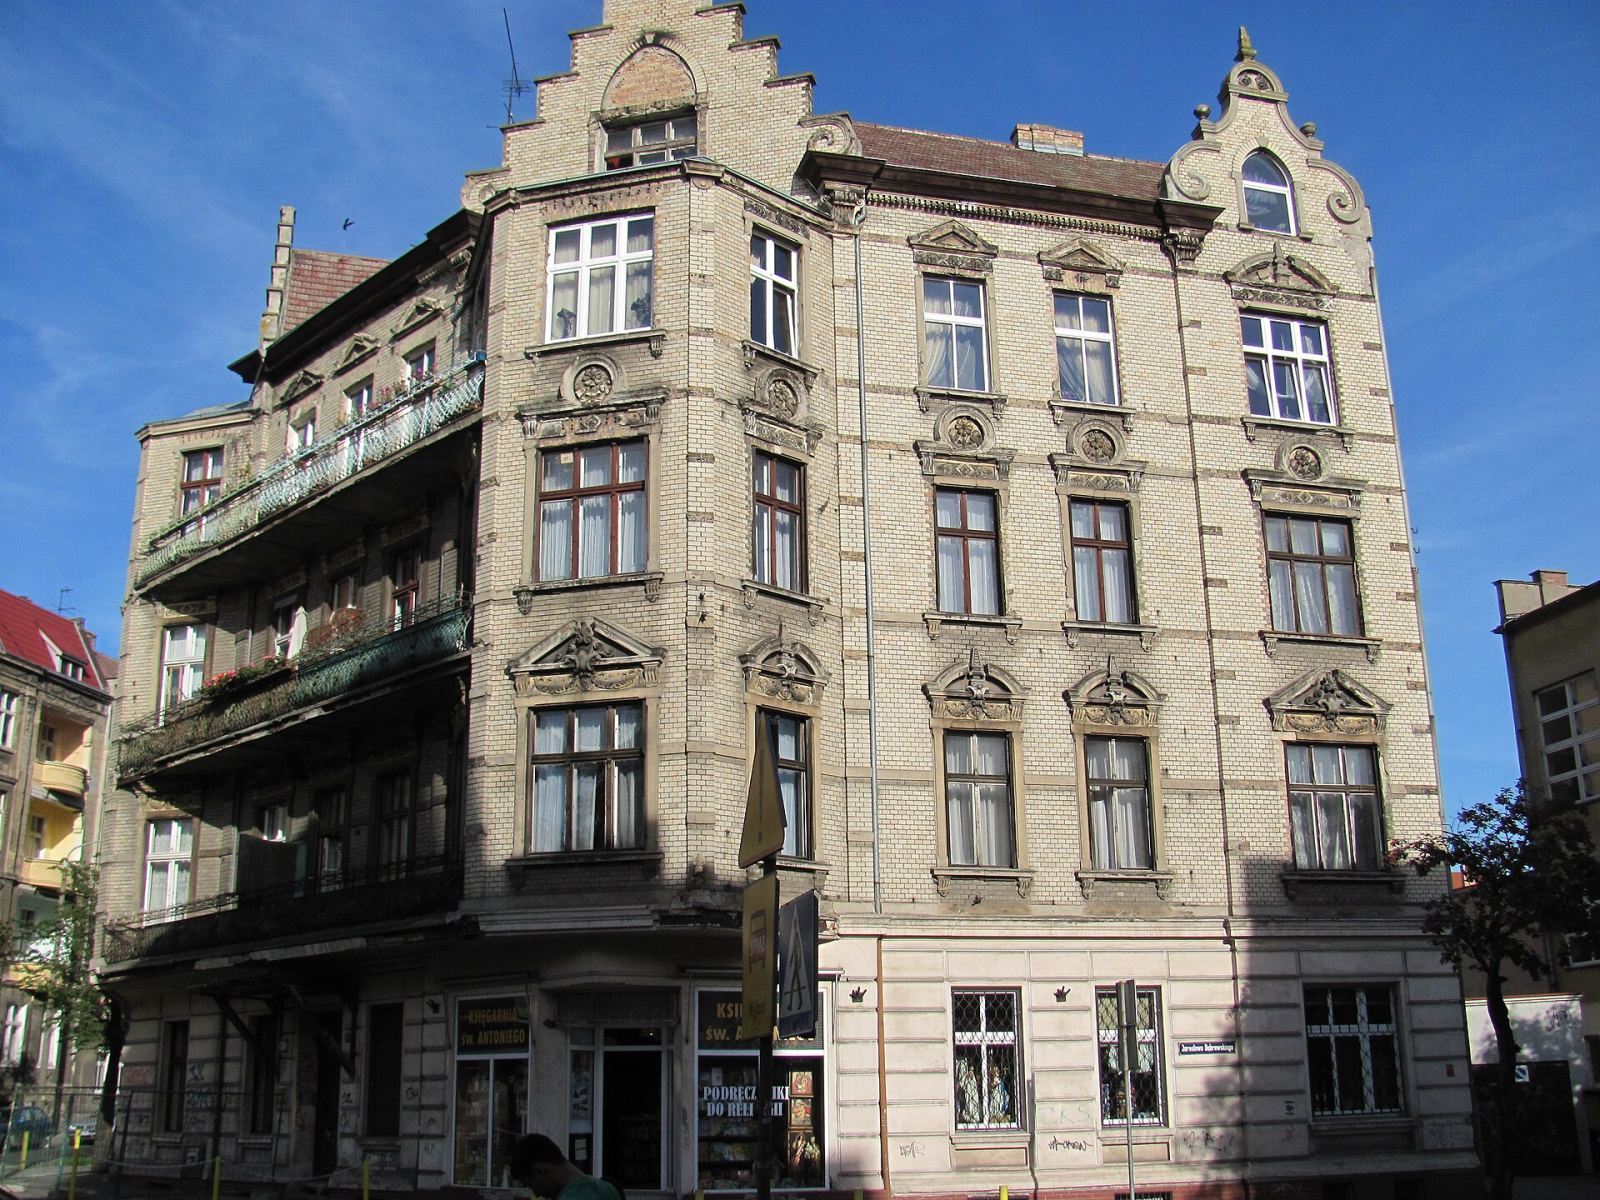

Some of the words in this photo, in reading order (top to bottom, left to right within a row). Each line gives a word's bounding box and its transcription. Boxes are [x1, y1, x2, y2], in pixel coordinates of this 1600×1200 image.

[478, 1029, 526, 1046] ANTONIEGO
[703, 1086, 789, 1102] PODRĘCZIKI
[706, 1102, 724, 1117] DO
[727, 1102, 783, 1117] RELIII
